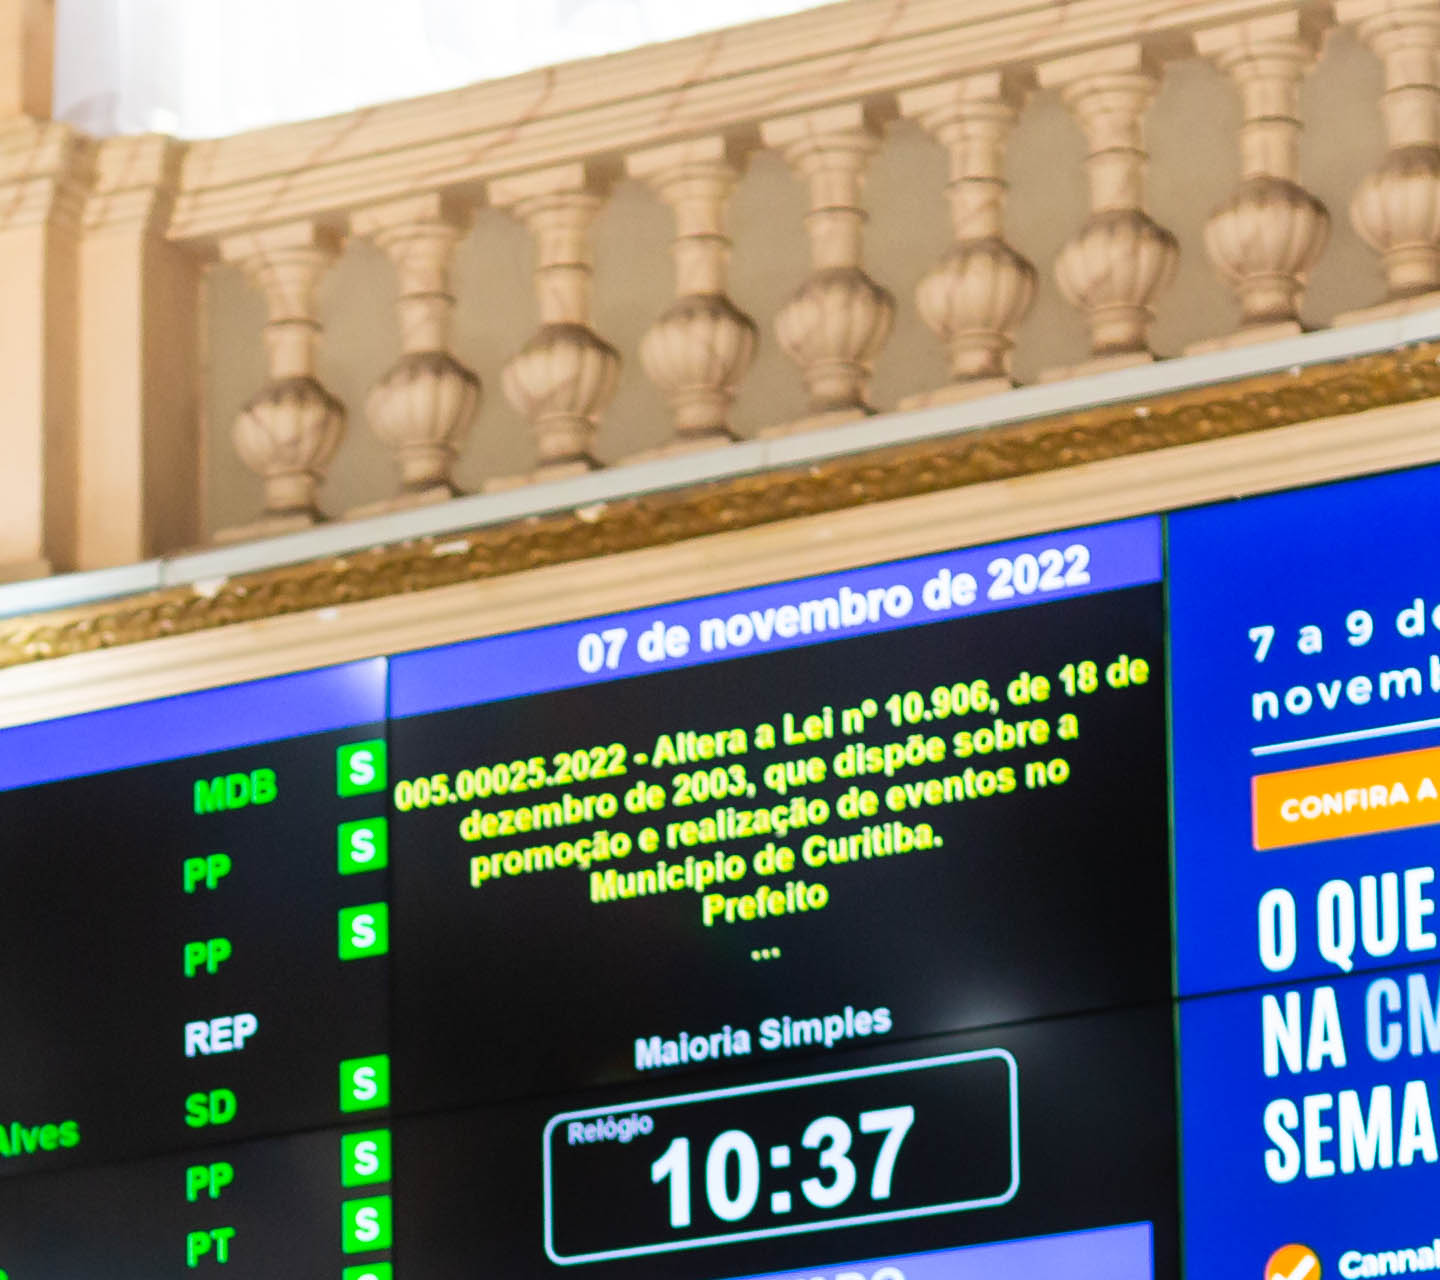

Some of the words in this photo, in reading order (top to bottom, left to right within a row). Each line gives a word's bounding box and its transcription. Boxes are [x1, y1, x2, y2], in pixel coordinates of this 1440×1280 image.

[577, 627, 628, 674] 07
[637, 620, 691, 663] de
[700, 580, 914, 653] novembro
[922, 568, 978, 611] de
[987, 544, 1091, 601] 2022
[1249, 627, 1275, 663] 7
[1298, 628, 1322, 656] a
[1347, 611, 1374, 648] 9
[393, 742, 628, 811] 005.00025.2022
[651, 727, 748, 768] Altera
[753, 723, 776, 750] a
[782, 705, 834, 746] Lei
[884, 679, 999, 728] 10.906,
[1006, 671, 1051, 706] de
[1058, 660, 1099, 697] 18
[1105, 654, 1150, 689] de
[459, 792, 618, 842] dezembro
[623, 780, 667, 814] de
[671, 763, 757, 807] 2003,
[763, 762, 822, 796] que
[832, 733, 946, 786] dispõe
[952, 718, 1051, 758] sobre
[1056, 713, 1079, 741] a
[1281, 783, 1409, 823] CONFIRA
[1418, 774, 1439, 798] A
[471, 821, 631, 888] promoção
[637, 827, 660, 854] e
[666, 795, 830, 849] realização
[835, 785, 880, 820] de
[886, 760, 1017, 812] eventos
[1024, 758, 1070, 789] no
[752, 842, 796, 876] de
[802, 820, 944, 868] Curitiba.
[702, 881, 830, 927] Prefeito
[1257, 888, 1297, 972] O
[1316, 868, 1436, 972] QUE
[184, 1013, 258, 1058] REP
[634, 1024, 752, 1071] Maioria
[759, 1005, 893, 1058] Simples
[1261, 985, 1346, 1078] NA
[568, 1112, 656, 1145] Relógio
[650, 1105, 915, 1229] 10:37
